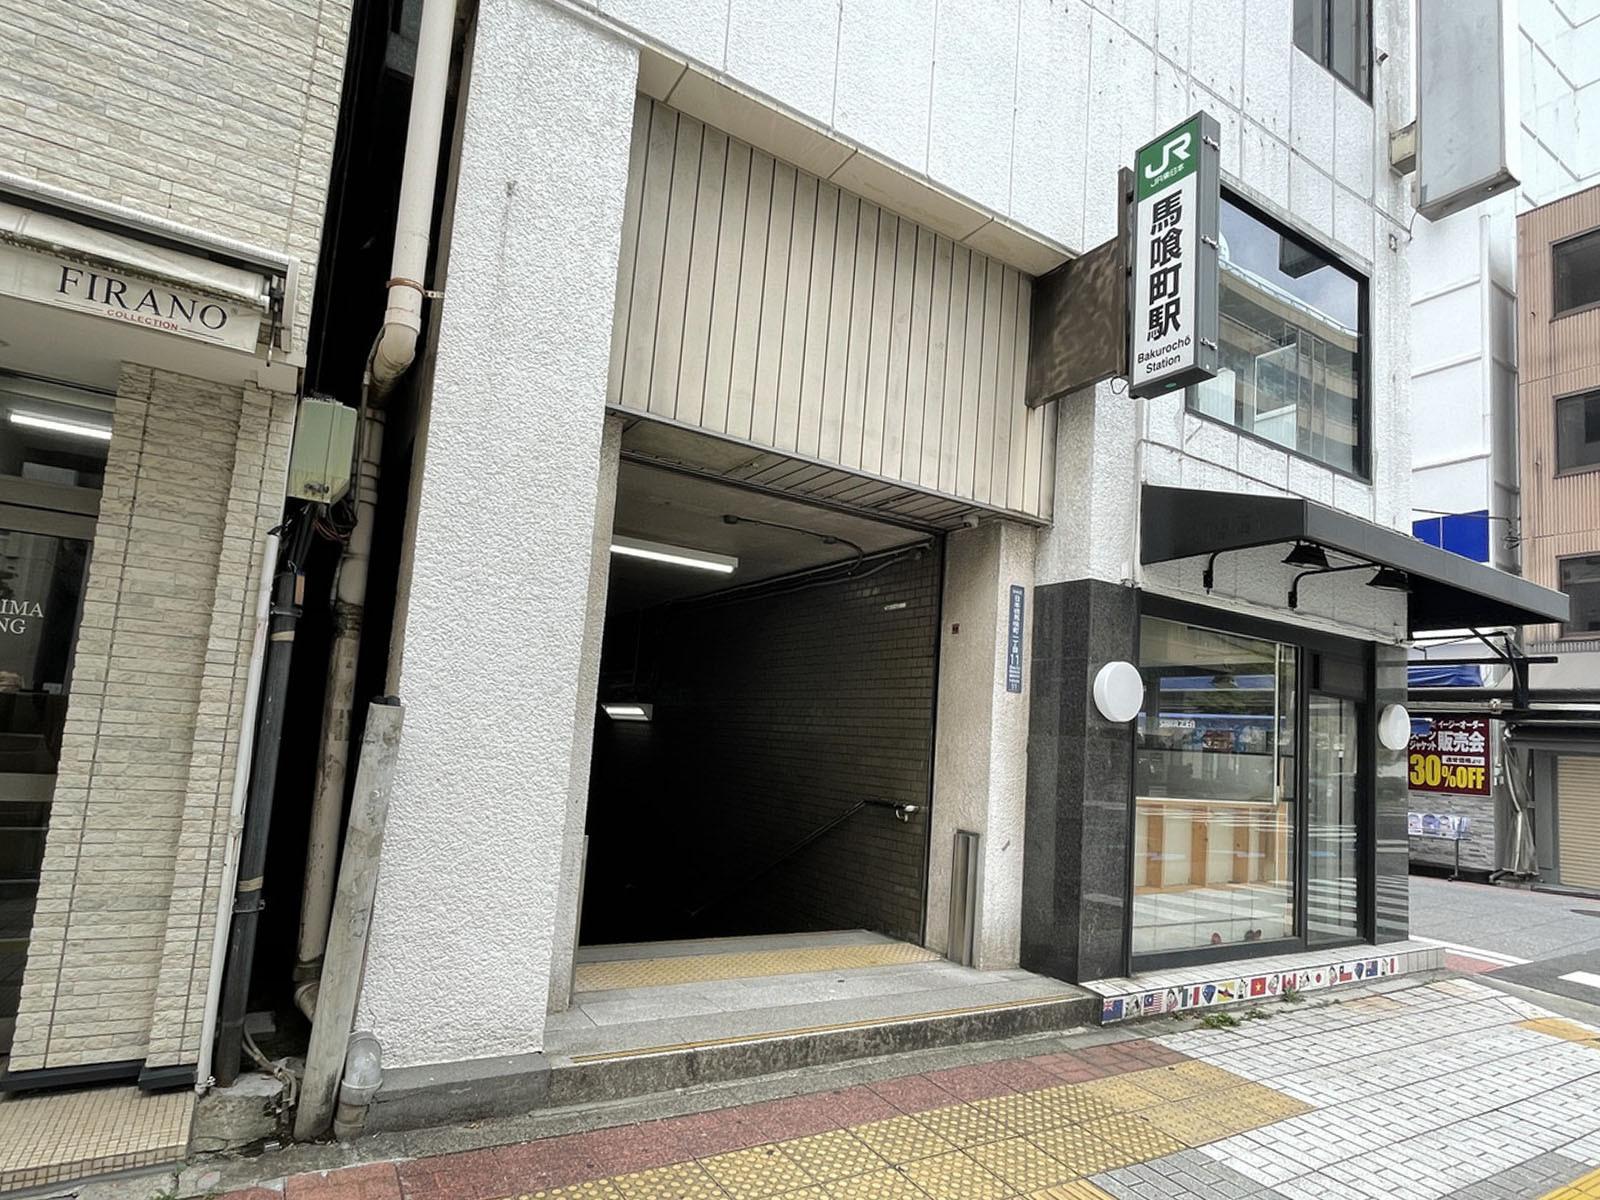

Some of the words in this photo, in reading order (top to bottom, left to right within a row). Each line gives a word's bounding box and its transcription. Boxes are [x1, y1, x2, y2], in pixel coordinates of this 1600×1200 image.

[1144, 132, 1192, 179] JR
[1147, 189, 1183, 342] 馬喰町駅
[56, 265, 228, 330] FIRANO
[107, 309, 179, 331] COLLECTION
[1145, 355, 1181, 374] Station
[1438, 720, 1485, 729] イージーオーダー
[1409, 740, 1437, 751] ジャケット
[1438, 730, 1485, 753] 販売会
